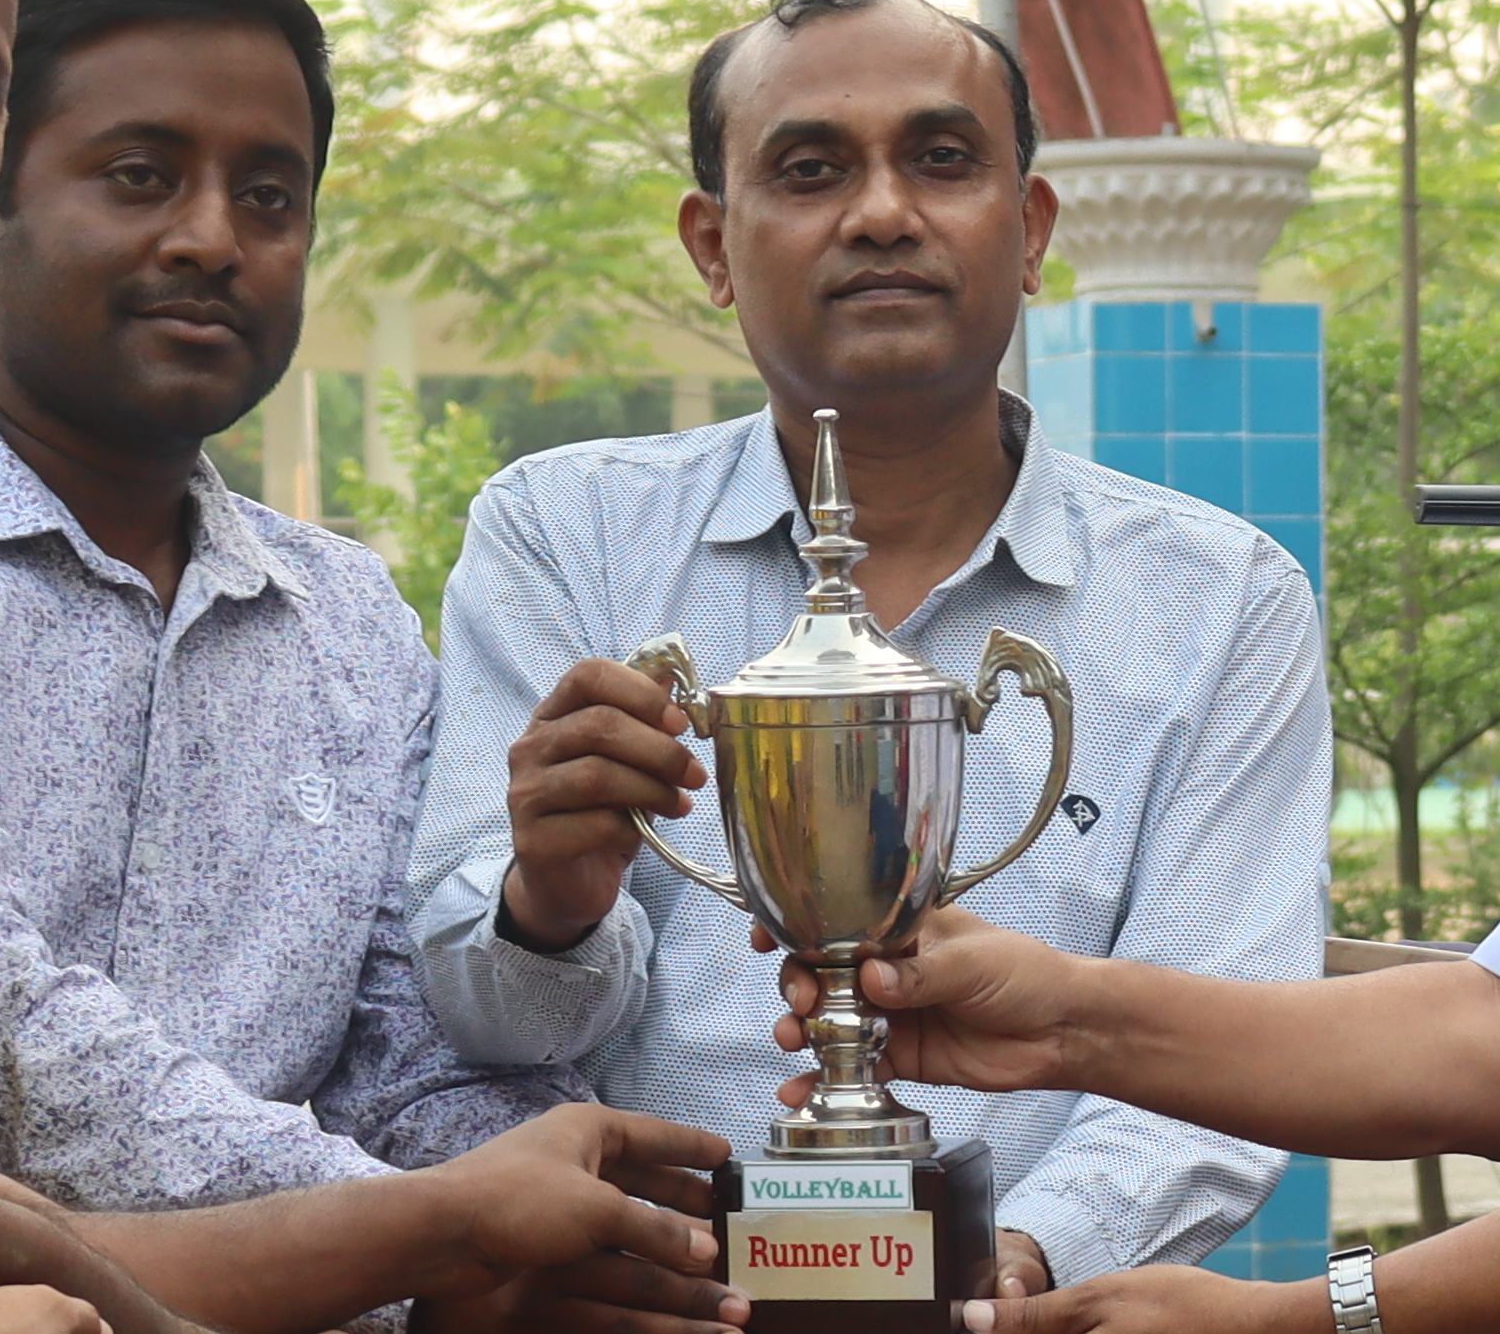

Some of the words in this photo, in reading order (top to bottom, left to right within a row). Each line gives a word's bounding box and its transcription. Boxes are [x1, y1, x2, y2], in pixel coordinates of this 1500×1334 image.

[750, 1177, 904, 1199] VOLLEYBALL
[748, 1236, 862, 1268] Runner
[870, 1235, 914, 1276] Up
